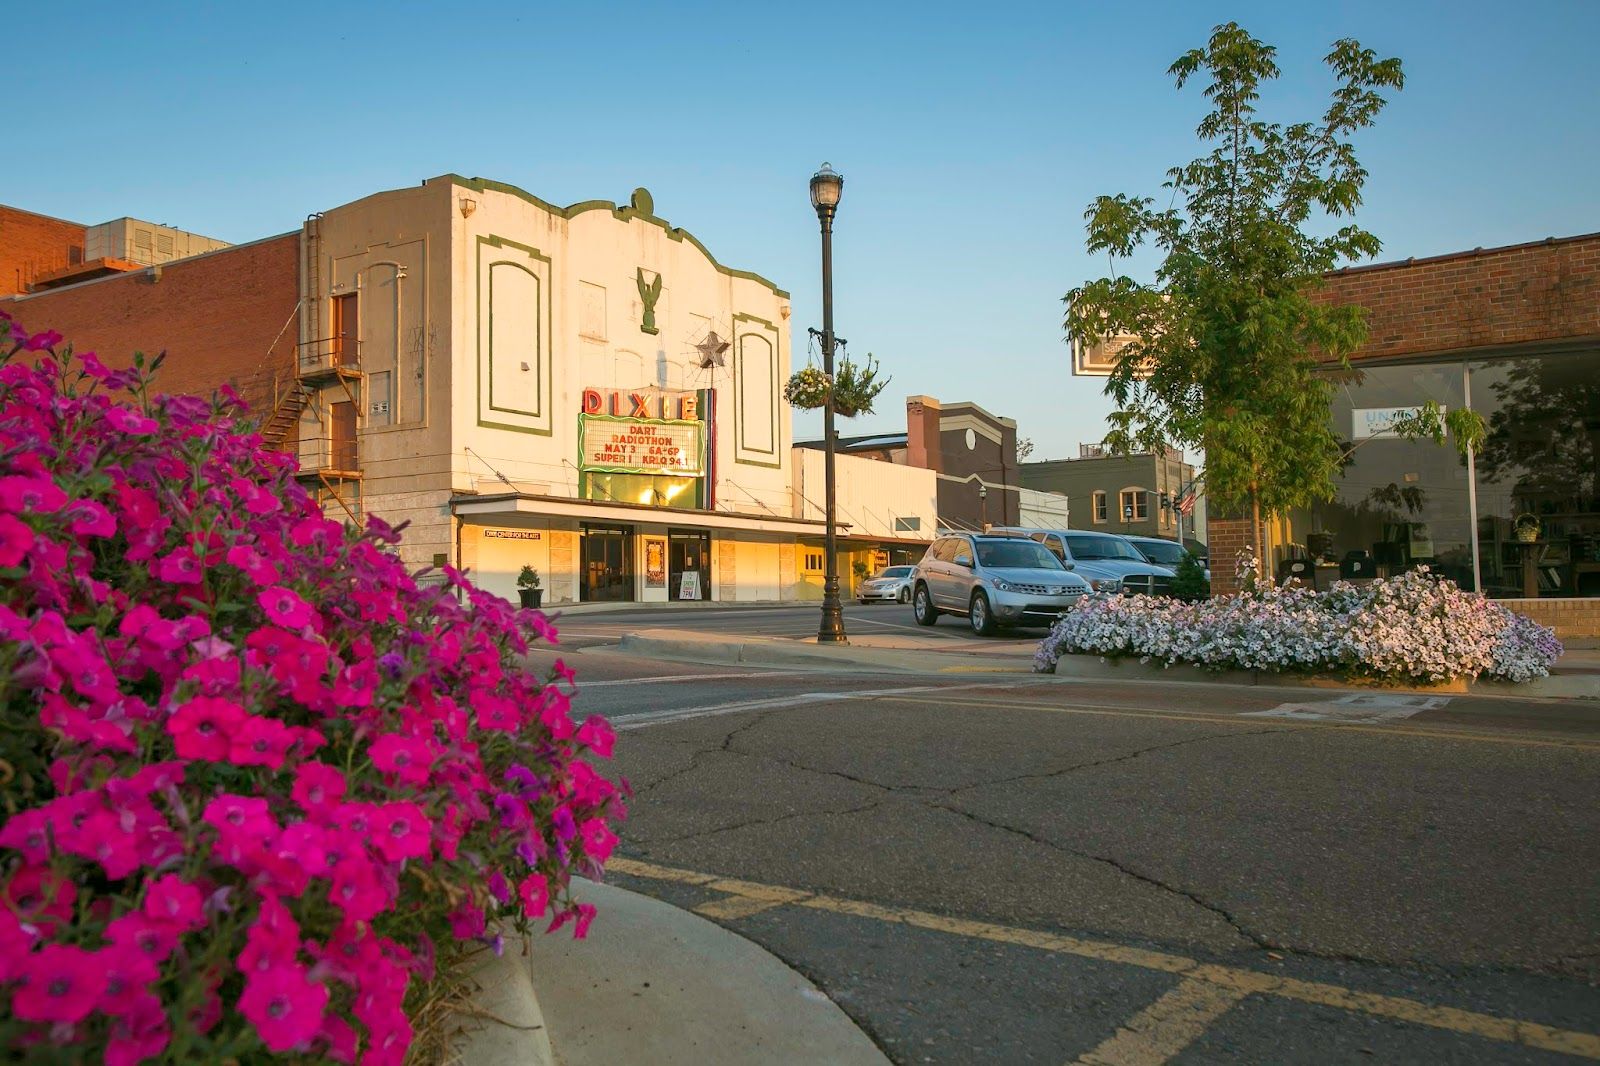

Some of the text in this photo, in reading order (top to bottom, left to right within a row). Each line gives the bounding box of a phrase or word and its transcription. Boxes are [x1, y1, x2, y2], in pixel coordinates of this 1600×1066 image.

[583, 390, 698, 420] DIXIE
[630, 426, 657, 435] DART
[612, 435, 672, 445] RADIOTHON
[605, 444, 680, 455] MAY 3 6A-6P
[594, 453, 625, 463] SUPER
